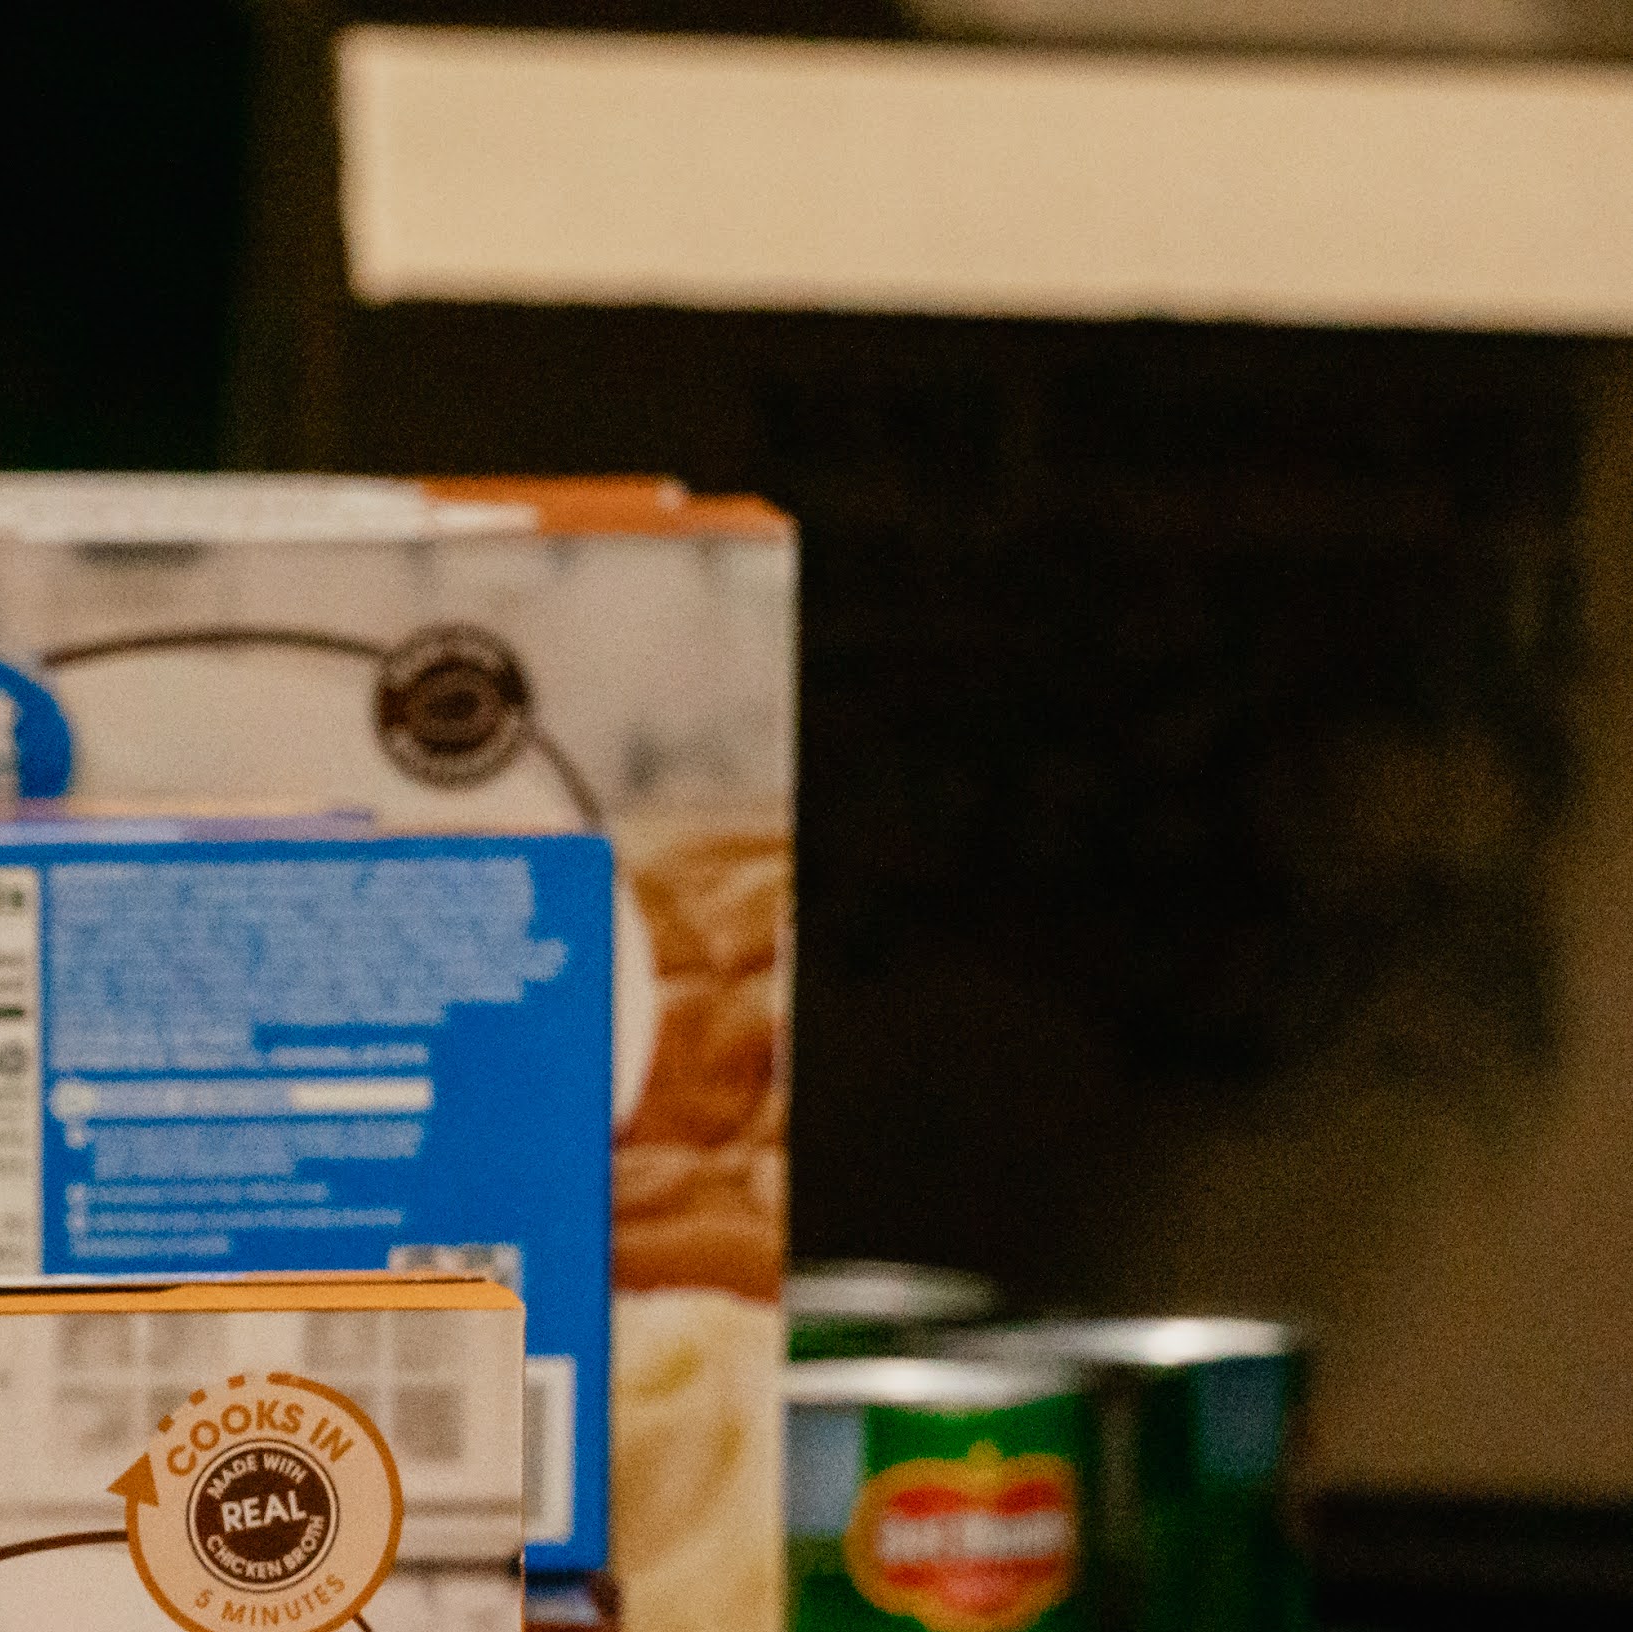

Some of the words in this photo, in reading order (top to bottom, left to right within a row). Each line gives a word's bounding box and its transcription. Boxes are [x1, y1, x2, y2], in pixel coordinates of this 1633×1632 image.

[166, 1399, 304, 1477] COOKS
[309, 1416, 354, 1463] IN
[207, 1454, 258, 1499] MADE
[263, 1453, 307, 1484] WITH
[221, 1490, 307, 1533] REAL
[207, 1534, 283, 1579] CHICKEN
[285, 1515, 325, 1571] BROTH
[194, 1588, 213, 1609] 5
[221, 1574, 346, 1626] MINUTES
